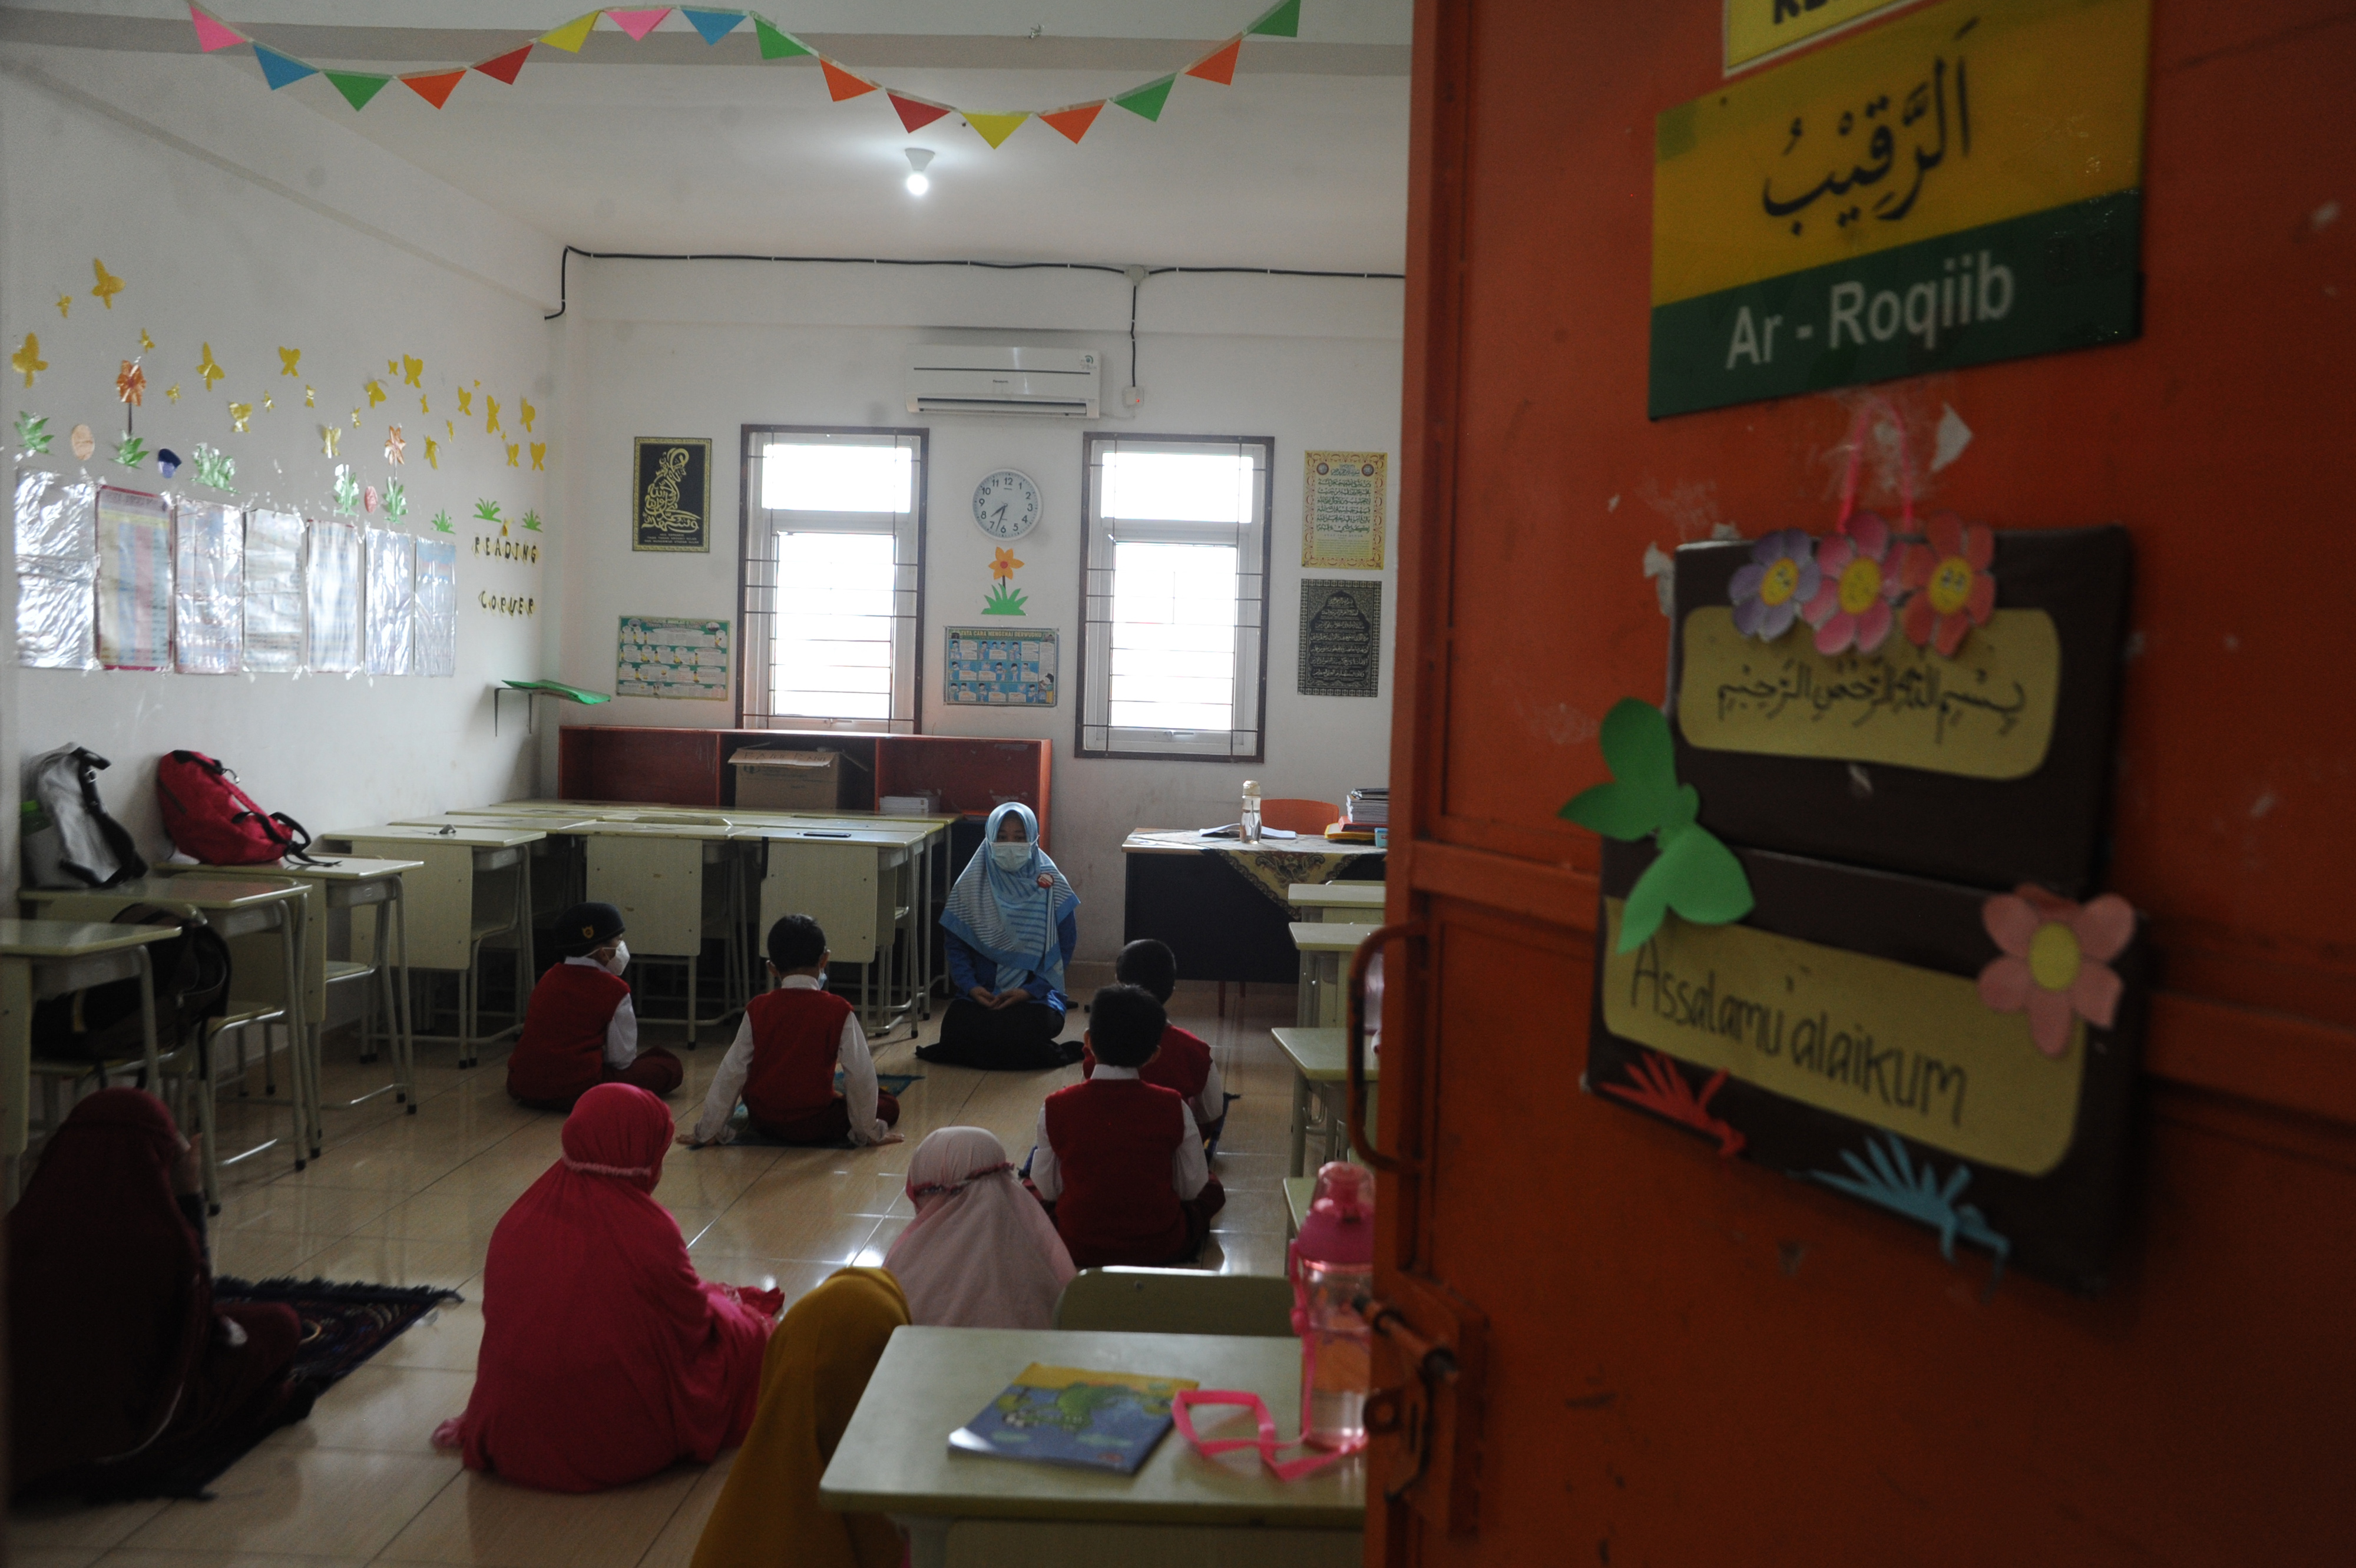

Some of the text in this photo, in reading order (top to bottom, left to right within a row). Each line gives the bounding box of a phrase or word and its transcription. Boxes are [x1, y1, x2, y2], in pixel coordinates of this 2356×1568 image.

[1726, 305, 1782, 370] Ar
[1829, 250, 2014, 349] Roqiib
[992, 479, 999, 487] 11
[1004, 477, 1013, 485] 12
[982, 487, 991, 495] 10
[1025, 491, 1031, 499] 2
[979, 498, 985, 507] 9
[1027, 503, 1033, 512] 3
[981, 511, 987, 519] 8
[1021, 515, 1028, 523] 4
[990, 521, 995, 529] 7
[1012, 523, 1018, 531] 5
[1000, 525, 1006, 534] 6
[475, 537, 537, 564] READING
